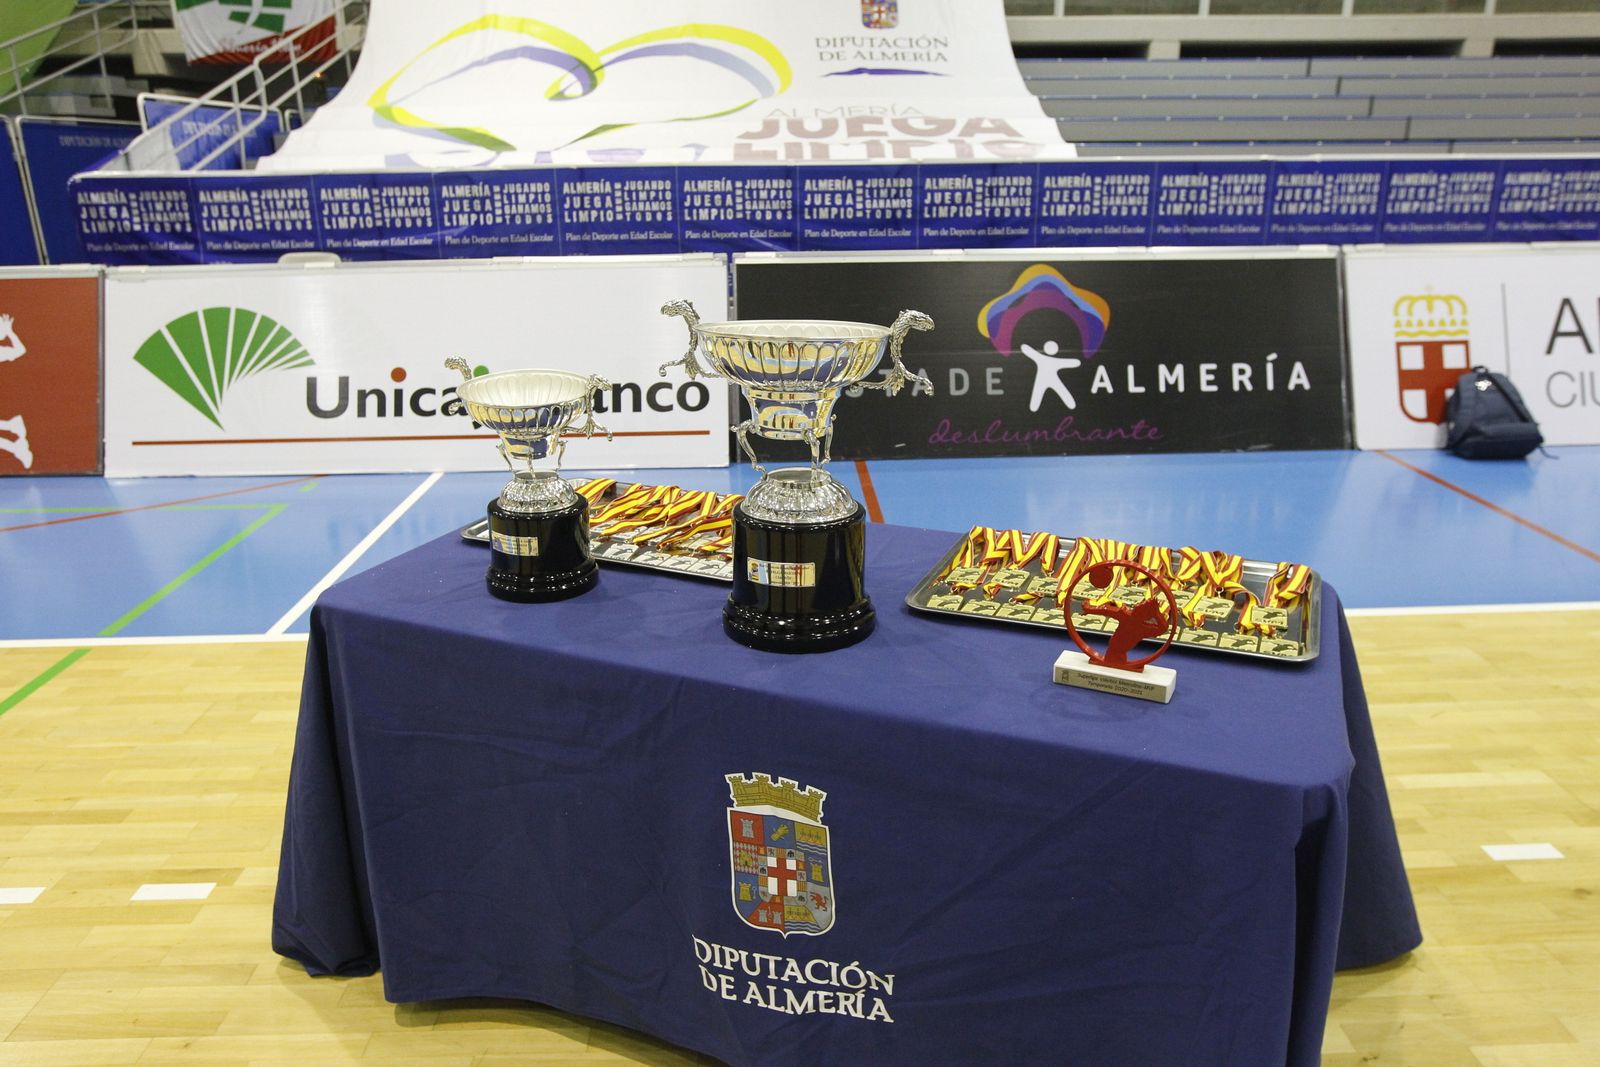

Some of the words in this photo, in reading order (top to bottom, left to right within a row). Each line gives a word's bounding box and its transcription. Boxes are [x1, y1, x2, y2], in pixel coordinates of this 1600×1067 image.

[815, 35, 949, 49] DIPUTACIÓN
[818, 51, 847, 62] DE
[852, 49, 949, 63] ALMERÍA
[736, 116, 1026, 139] JUEGA
[624, 180, 671, 190] JUGANDO
[684, 177, 733, 192] ALMERÍA
[745, 179, 792, 189] JUGANDO
[804, 176, 853, 191] ALMERÍA
[865, 178, 913, 188] JUGANDO
[925, 174, 974, 190] ALMERÍA
[985, 176, 1032, 186] JUGANDO
[1044, 173, 1092, 188] ALMERÍA
[1161, 172, 1209, 187] ALMERÍA
[320, 185, 370, 201] ALMERÍA
[381, 186, 429, 197] JUGANDO
[442, 182, 491, 198] ALMERÍA
[502, 182, 550, 193] JUGANDO
[563, 179, 612, 194] ALMERÍA
[865, 188, 913, 198] LIMPIO
[984, 187, 1032, 196] LIMPIO
[77, 189, 127, 205] ALMERÍA
[198, 188, 249, 204] ALMERÍA
[260, 188, 308, 199] JUGANDO
[503, 193, 551, 204] LIMPIO
[624, 191, 672, 201] LIMPIO
[745, 190, 792, 199] LIMPIO
[804, 193, 853, 206] JUEGA
[924, 191, 972, 204] JUEGA
[1043, 190, 1091, 202] JUEGA
[1159, 189, 1207, 201] JUEGA
[261, 199, 309, 210] LIMPIO
[382, 197, 430, 207] LIMPIO
[443, 199, 492, 212] JUEGA
[564, 195, 612, 209] JUEGA
[625, 201, 672, 212] GANAMOS
[684, 194, 733, 207] JUEGA
[745, 200, 792, 210] GANAMOS
[865, 199, 912, 209] GANAMOS
[984, 197, 1031, 207] GANAMOS
[79, 206, 129, 219] JUEGA
[200, 205, 251, 218] JUEGA
[263, 210, 311, 220] GANAMOS
[322, 202, 371, 215] JUEGA
[384, 207, 431, 218] GANAMOS
[504, 204, 552, 214] GANAMOS
[684, 208, 733, 221] LIMPIO
[804, 207, 853, 219] LIMPIO
[865, 209, 912, 218] TODOS
[924, 205, 973, 218] LIMPIO
[984, 208, 1031, 217] TODOS
[1042, 204, 1091, 216] LIMPIO
[1158, 203, 1207, 215] LIMPIO
[444, 213, 493, 226] LIMPIO
[505, 214, 552, 224] TODOS
[564, 210, 613, 223] LIMPIO
[626, 212, 672, 221] TODOS
[746, 211, 792, 220] TODOS
[82, 220, 132, 233] LIMPIO
[203, 218, 253, 232] LIMPIO
[265, 220, 312, 230] TODOS
[324, 216, 373, 229] LIMPIO
[385, 218, 432, 227] TODOS
[1545, 297, 1600, 354] A
[949, 367, 1005, 396] DE
[1091, 352, 1312, 393] ALMERÍA
[306, 365, 490, 430] Unica
[590, 379, 710, 415] nco
[927, 416, 1165, 445] deslumbrante
[691, 934, 896, 996] DIPUTACIÓN
[699, 964, 738, 1000] DE
[743, 981, 894, 1023] ALMERÍA
